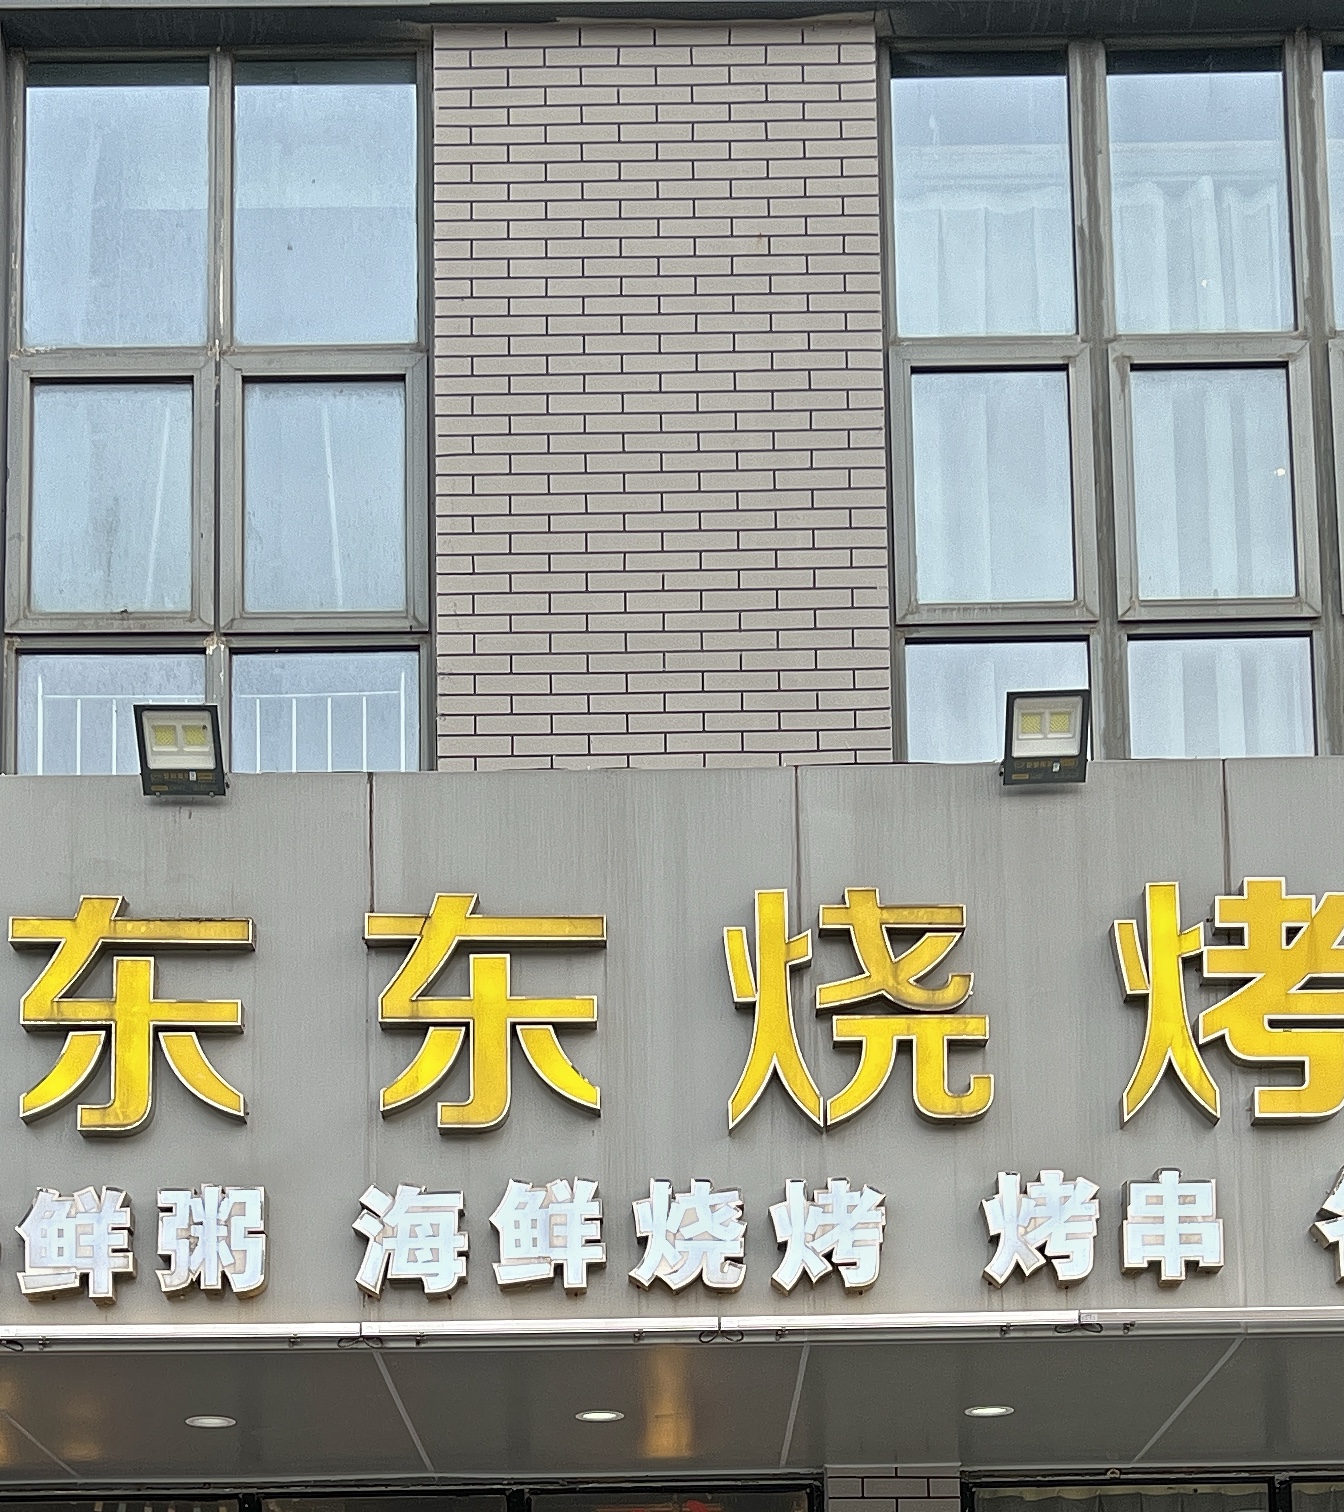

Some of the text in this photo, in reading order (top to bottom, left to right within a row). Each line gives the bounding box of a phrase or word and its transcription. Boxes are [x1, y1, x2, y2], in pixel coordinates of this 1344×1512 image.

[351, 1176, 888, 1298] 海鲜烧烤
[981, 1168, 1224, 1289] 烤串
